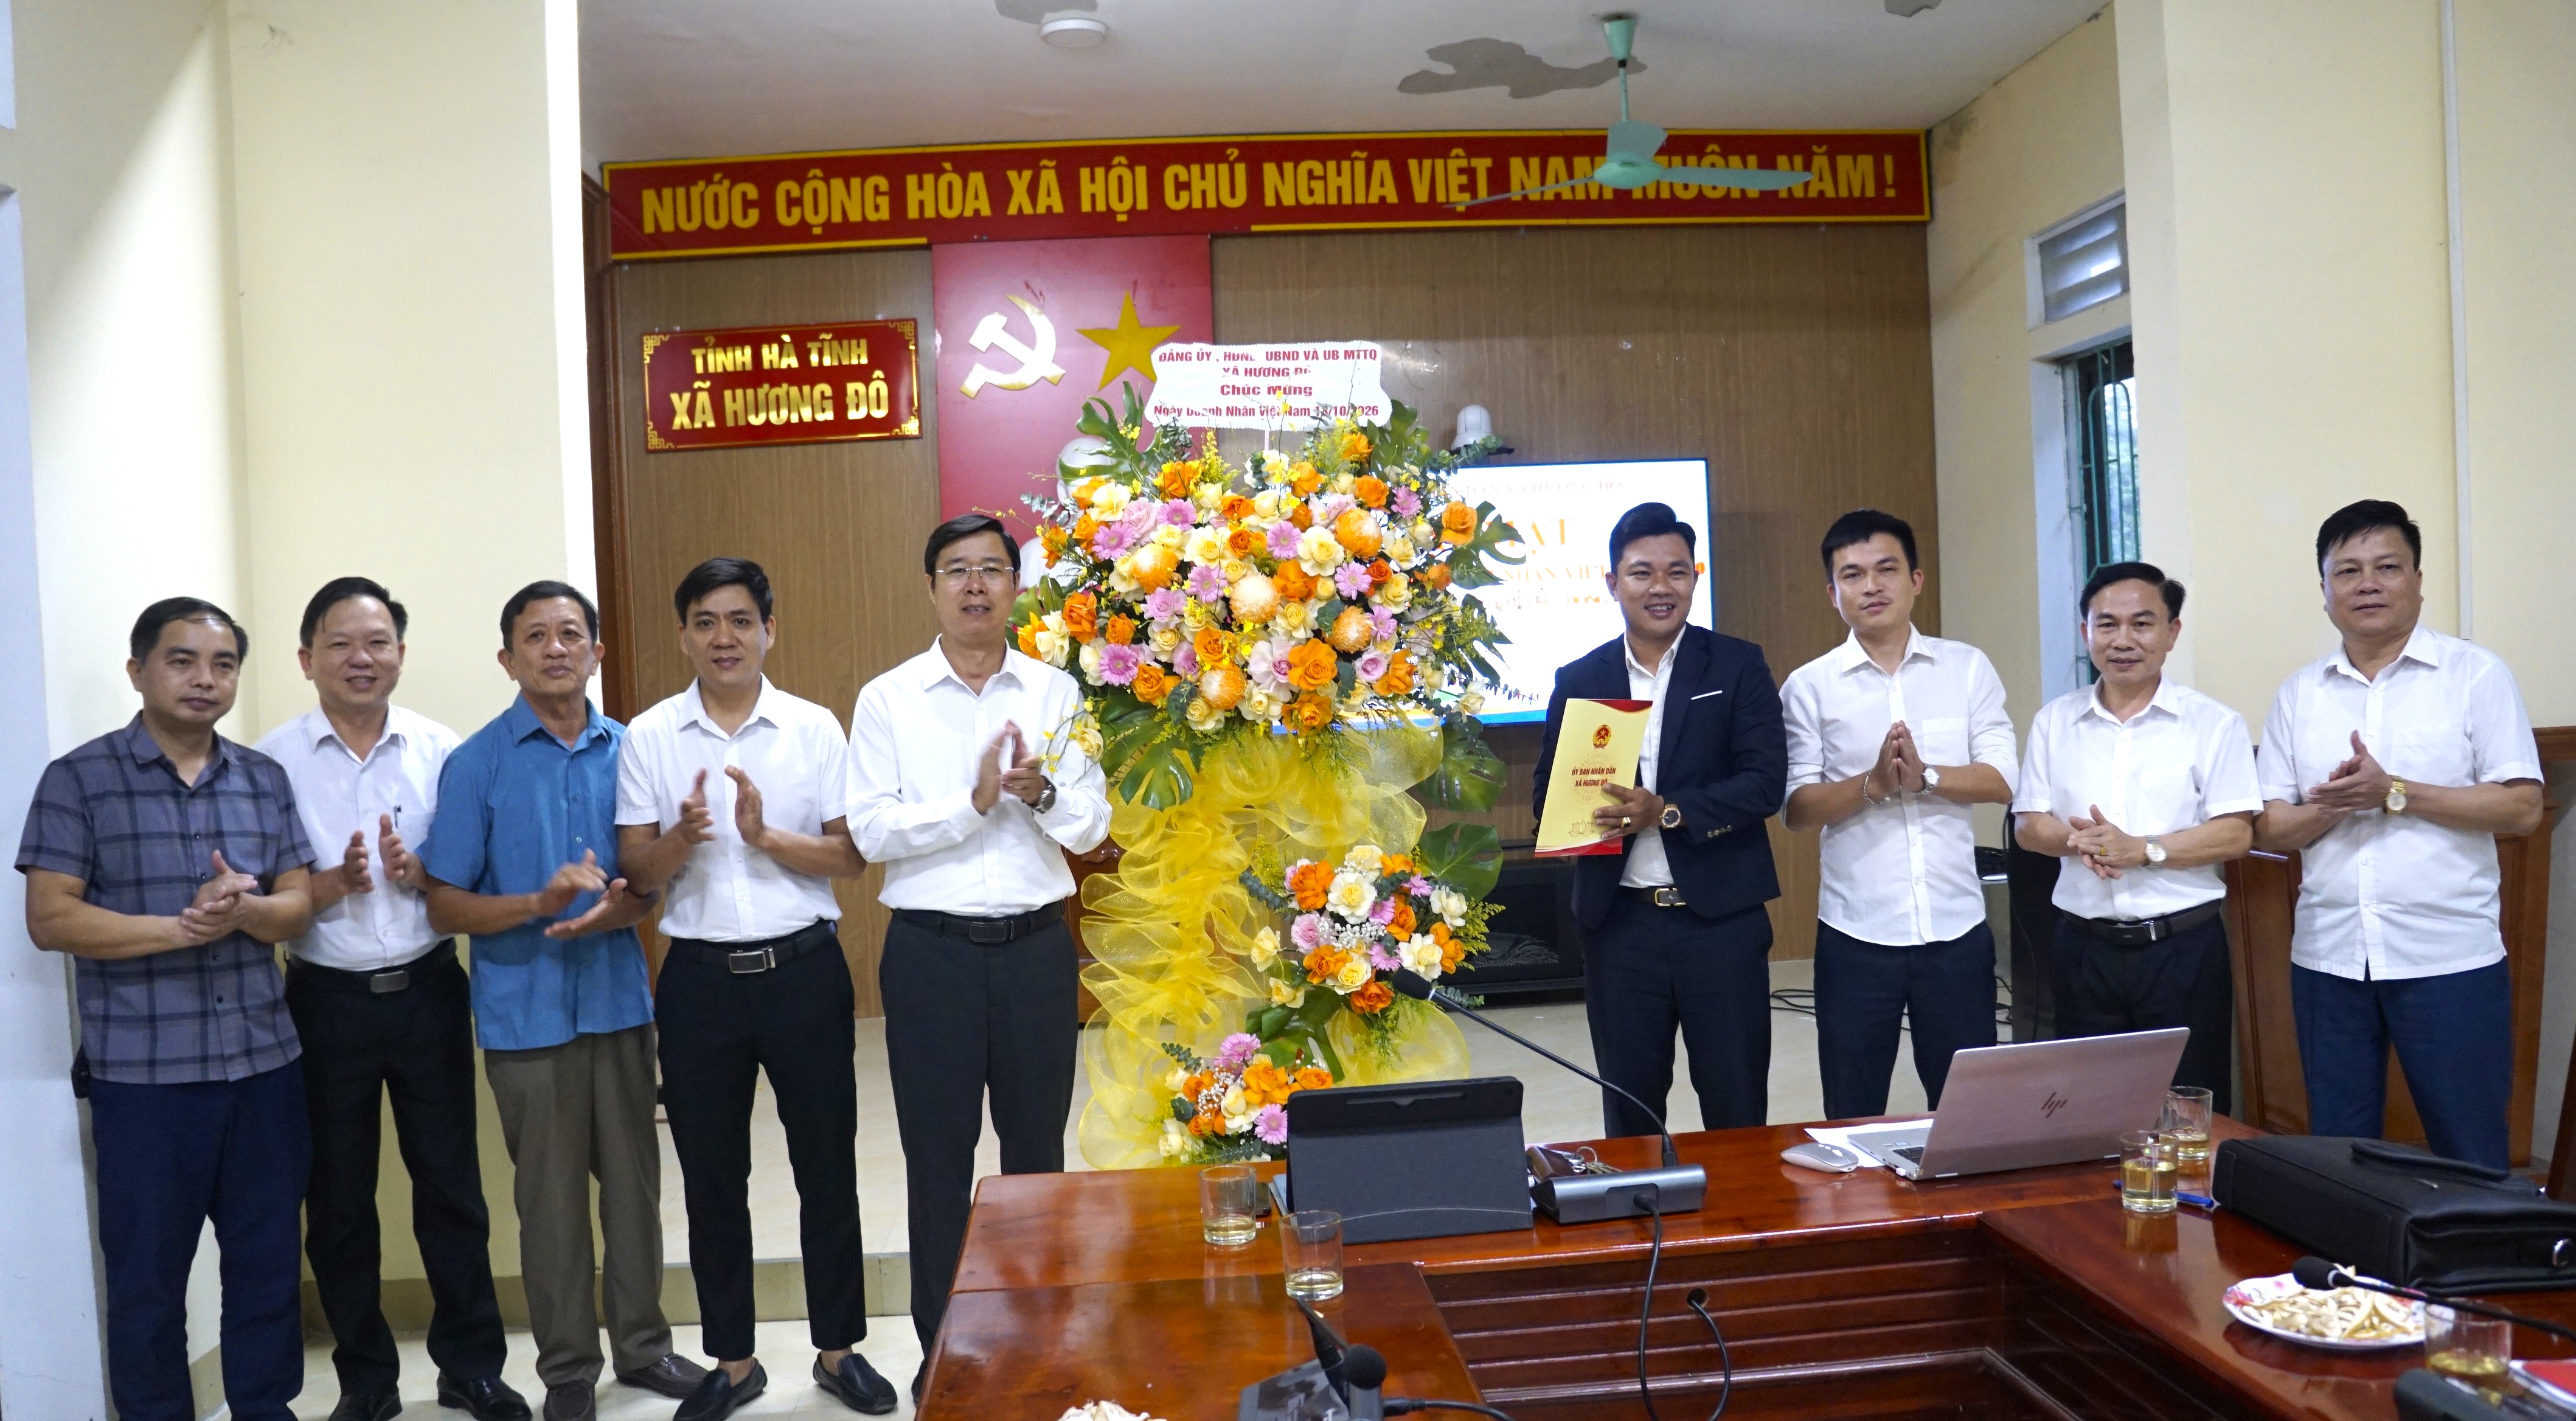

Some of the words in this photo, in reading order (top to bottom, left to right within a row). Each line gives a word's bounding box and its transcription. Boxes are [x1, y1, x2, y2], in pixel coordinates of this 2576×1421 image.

[642, 173, 759, 234] NƯỚC
[776, 169, 890, 235] CỘNG
[906, 162, 991, 220] HÒA
[1006, 159, 1064, 215] XÃ
[1080, 156, 1148, 222] HỘI
[1163, 148, 1247, 210] CHỦ
[1263, 150, 1398, 207] NGHĨA
[1408, 148, 1492, 212] VIỆT
[1510, 156, 1614, 201] NAM
[691, 336, 753, 373] TỈNH
[762, 335, 799, 369] HÀ
[807, 333, 868, 367] TĨNH
[1158, 349, 1193, 363] ĐẢNG
[1196, 348, 1212, 361] ỦY
[1265, 350, 1300, 361] UBND
[1304, 348, 1319, 361] VÀ
[1323, 350, 1339, 361] UB
[1344, 349, 1377, 361] MTTQ
[1244, 366, 1290, 378] HƯƠNG
[1220, 384, 1261, 396] Chúc
[670, 381, 715, 430] XÃ
[724, 383, 835, 427] HƯƠNG
[845, 370, 889, 420] ĐÔ
[1226, 406, 1255, 417] Nhân
[1571, 766, 1579, 776] ỦY
[1591, 766, 1605, 775] NHÂN
[1605, 766, 1616, 775] DÂN
[2040, 1092, 2067, 1118] hp
